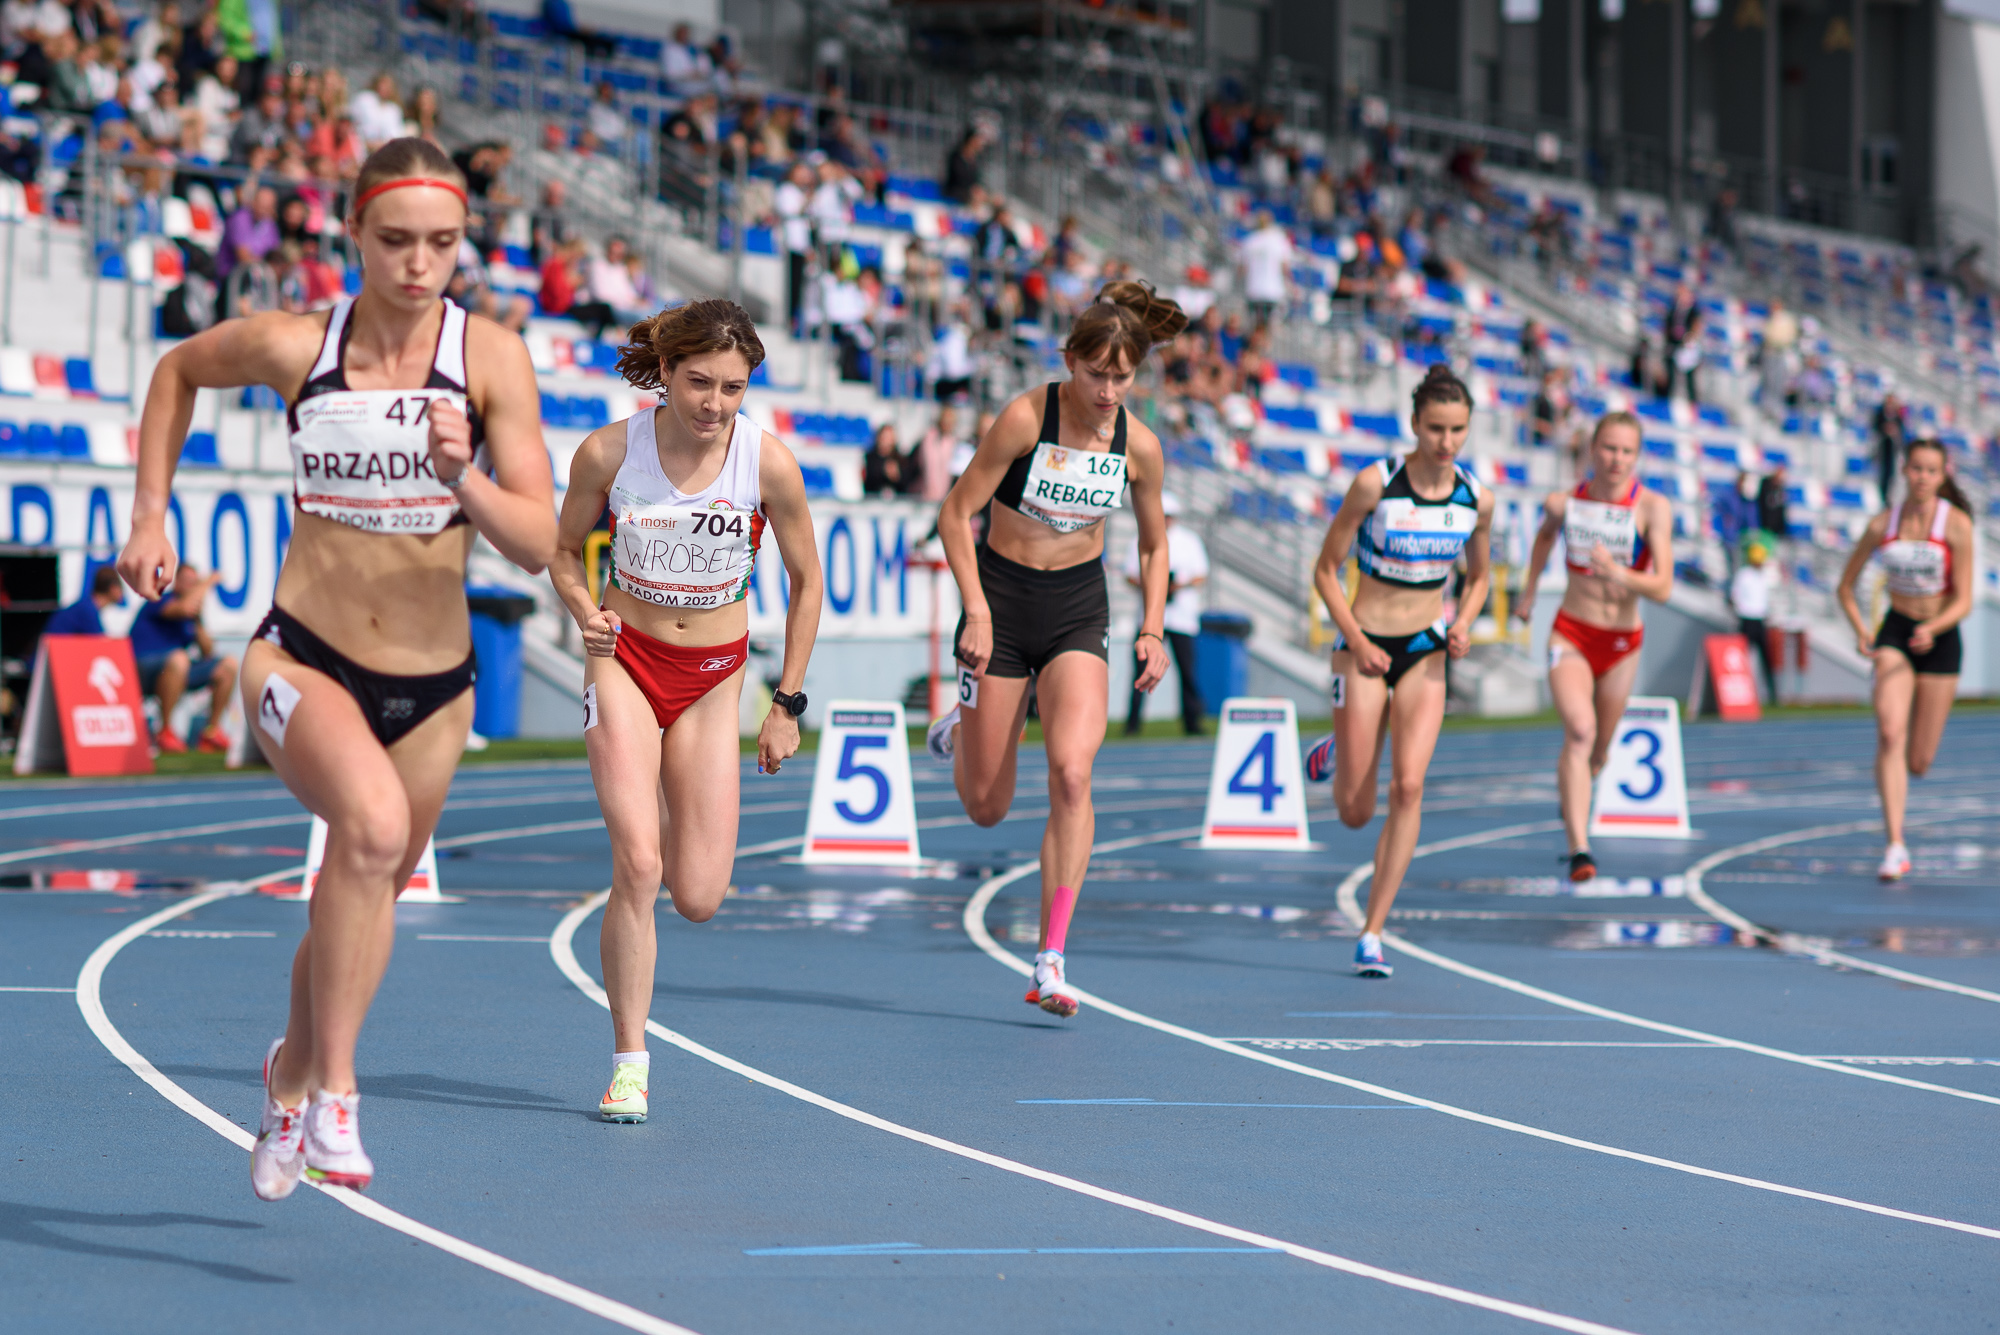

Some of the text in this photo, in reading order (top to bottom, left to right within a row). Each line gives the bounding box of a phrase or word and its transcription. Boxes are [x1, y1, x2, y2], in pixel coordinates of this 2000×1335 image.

[302, 451, 434, 487] PRZĄDK
[1087, 456, 1122, 476] 167
[1036, 478, 1115, 508] RĘBACZ
[391, 513, 435, 528] 2022
[640, 517, 678, 529] mosir
[690, 512, 744, 538] 704
[1444, 511, 1454, 527] 8
[627, 583, 717, 606] RADOM 2022
[638, 579, 695, 592] MISTRZOSTWA
[696, 585, 723, 593] POLSKI
[961, 671, 973, 702] 5
[1228, 731, 1284, 813] 4
[1618, 728, 1664, 801] 3
[834, 735, 891, 824] 5
